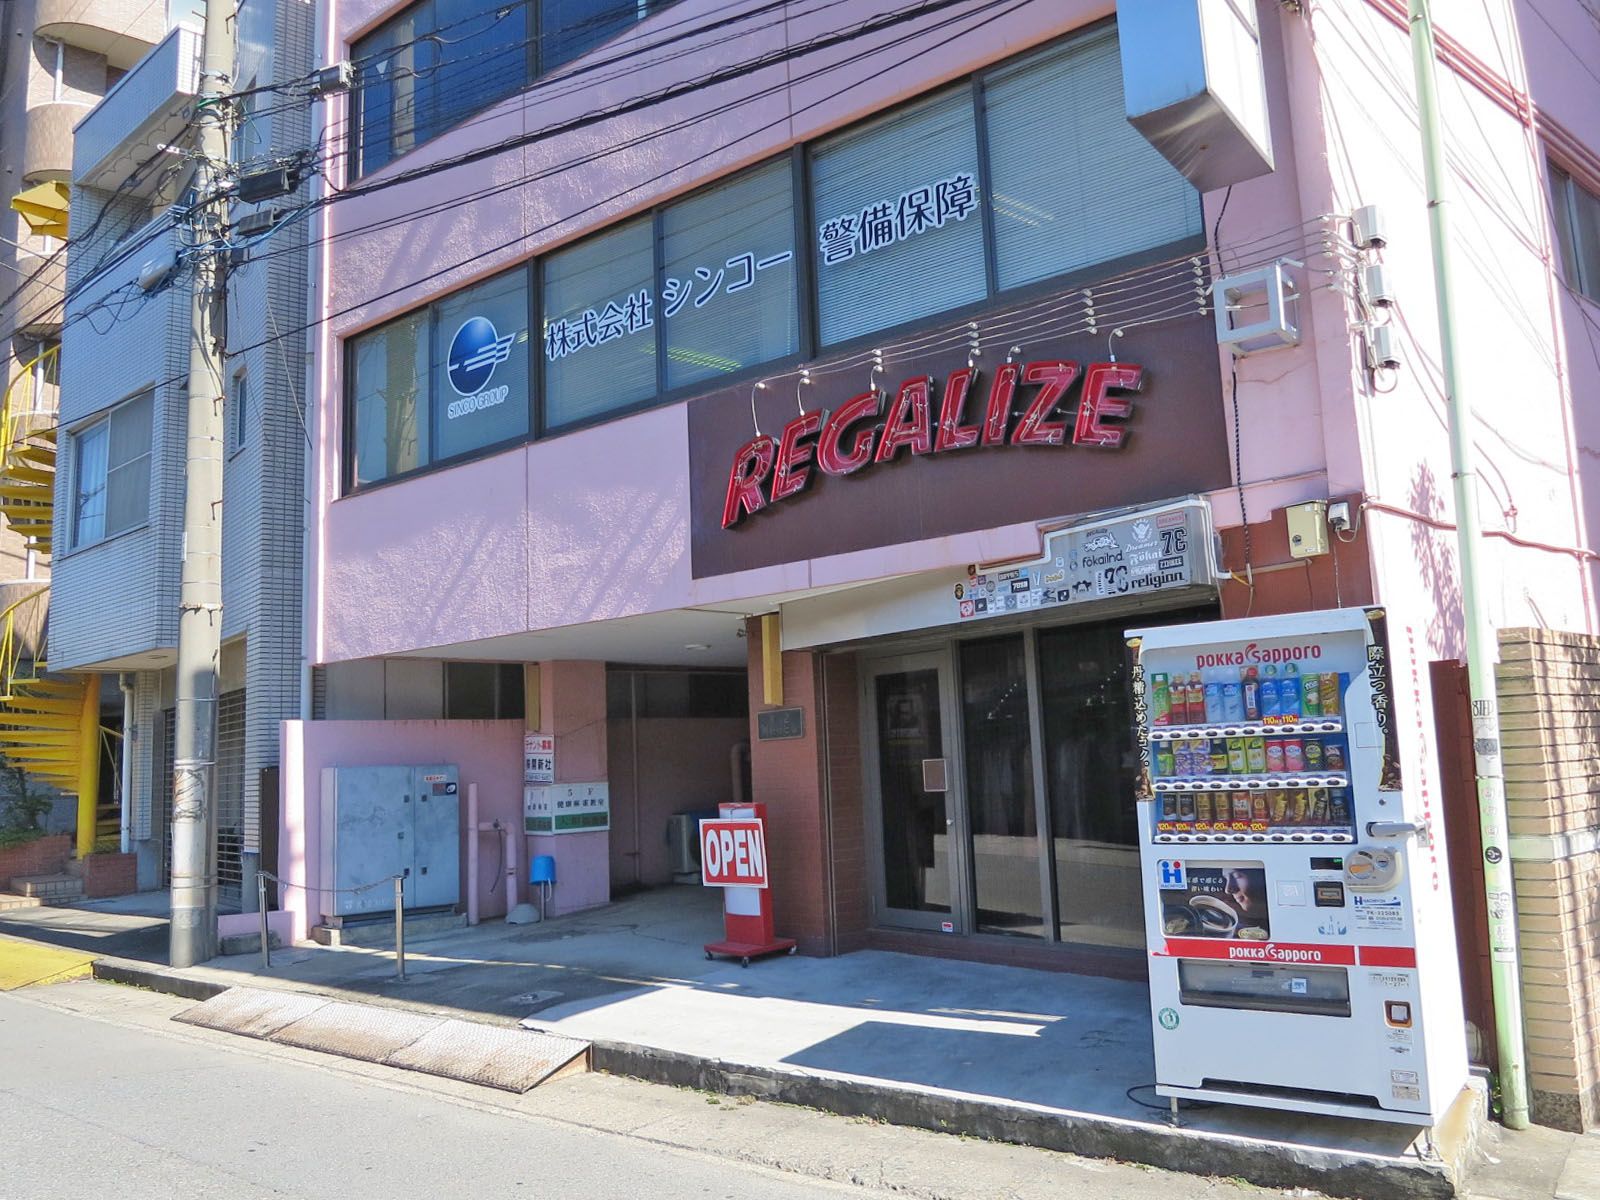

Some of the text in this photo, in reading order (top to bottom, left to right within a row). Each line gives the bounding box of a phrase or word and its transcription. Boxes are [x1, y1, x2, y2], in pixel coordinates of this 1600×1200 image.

[544, 172, 977, 361] 株式会社 シンコー 警備保障
[448, 385, 508, 419] SINCO GROUP
[721, 359, 1145, 529] REGALIZE
[705, 829, 764, 878] OPEN
